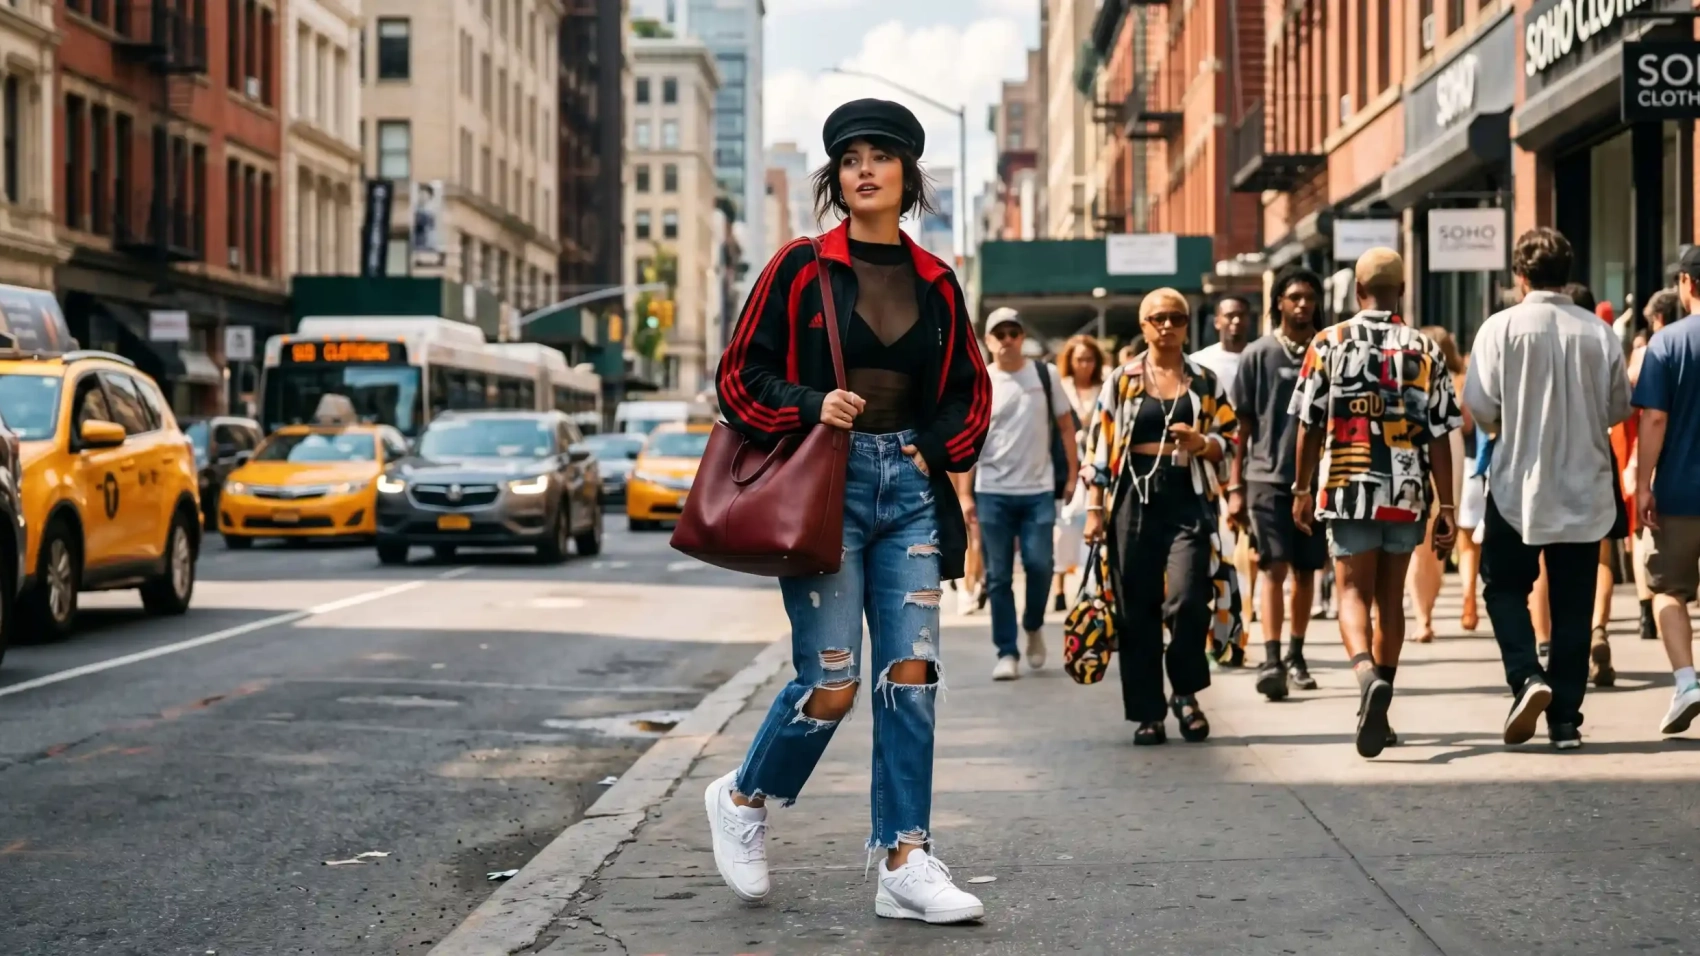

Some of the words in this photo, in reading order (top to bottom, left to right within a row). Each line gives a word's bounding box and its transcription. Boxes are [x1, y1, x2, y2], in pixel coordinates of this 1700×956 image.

[1526, 0, 1574, 77] SOHO
[1638, 53, 1700, 87] SO
[1638, 90, 1700, 107] CLOTH
[1438, 225, 1496, 240] SOHO
